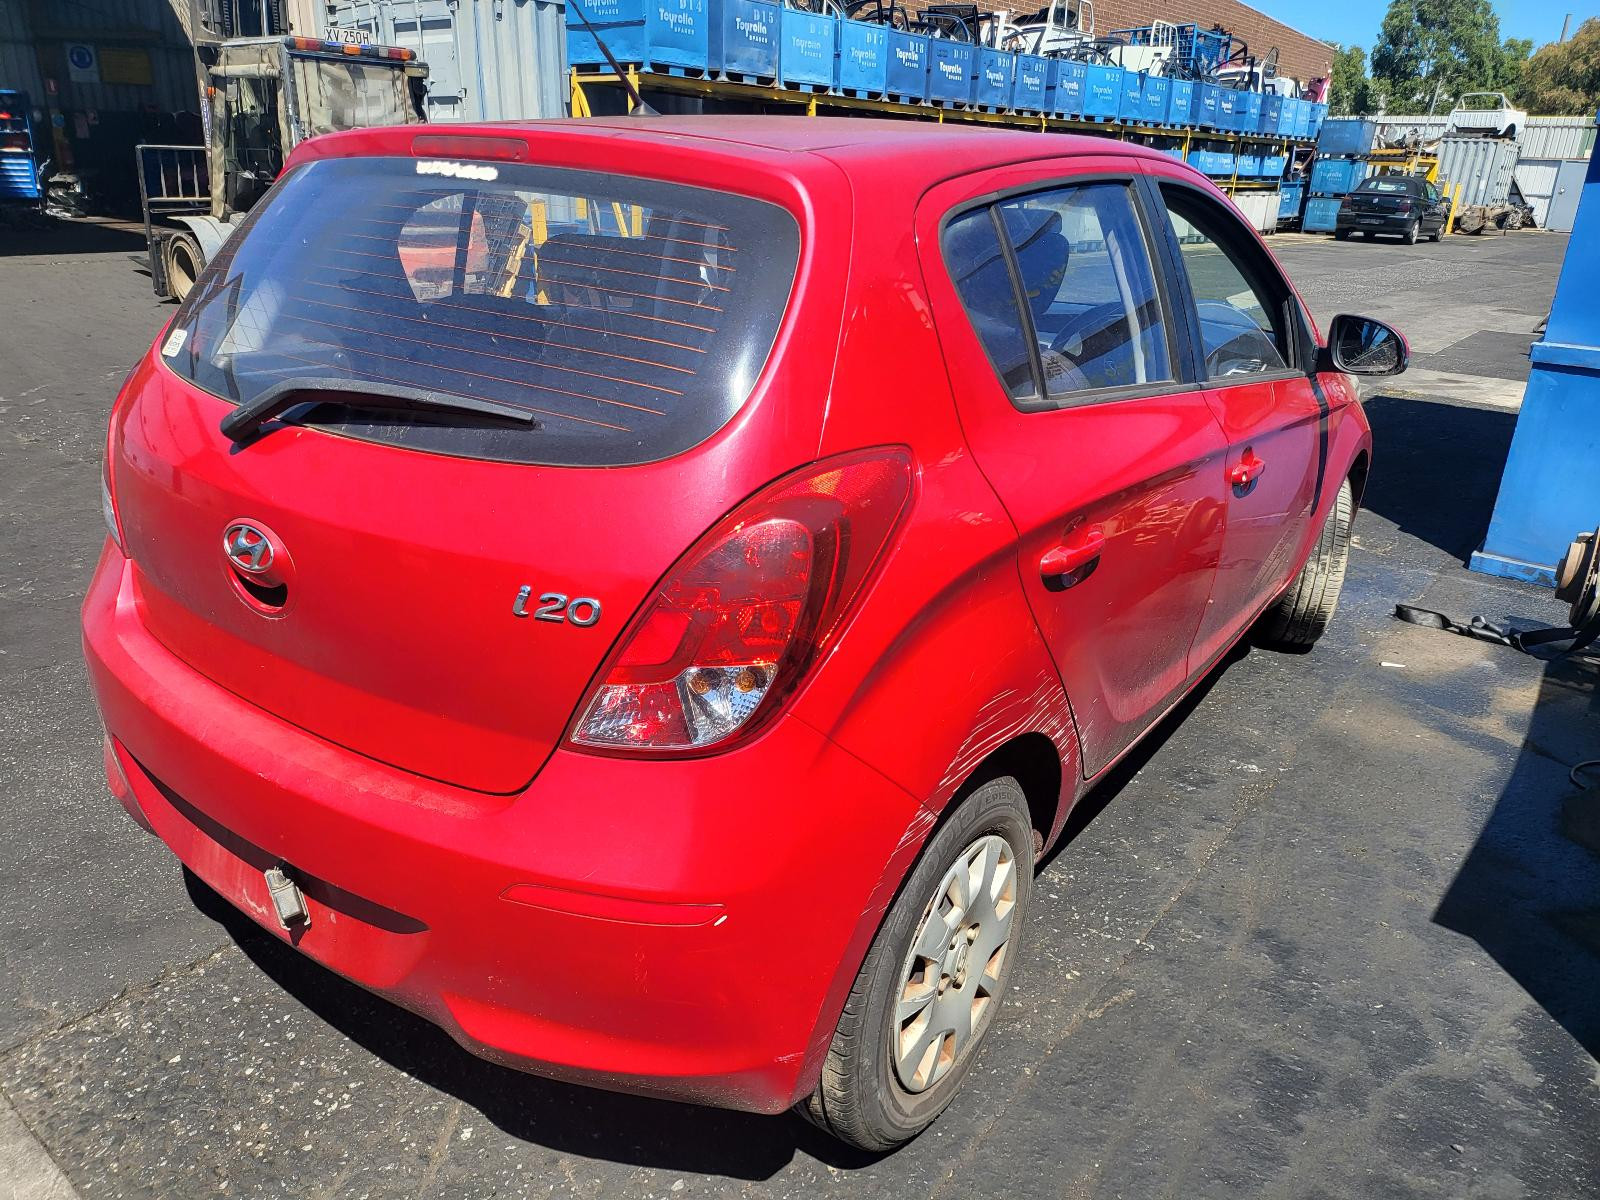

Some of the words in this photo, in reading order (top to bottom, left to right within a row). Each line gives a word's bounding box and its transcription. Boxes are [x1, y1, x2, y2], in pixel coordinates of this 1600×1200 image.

[658, 8, 694, 29] Toyrolla
[753, 9, 774, 24] D15
[325, 28, 340, 42] XV
[735, 17, 767, 38] Toyrolla
[866, 32, 884, 46] D17
[850, 47, 876, 63] Toyrolla
[895, 47, 919, 65] Toyrolla
[939, 61, 962, 77] Toyrolla
[511, 584, 602, 628] i20
